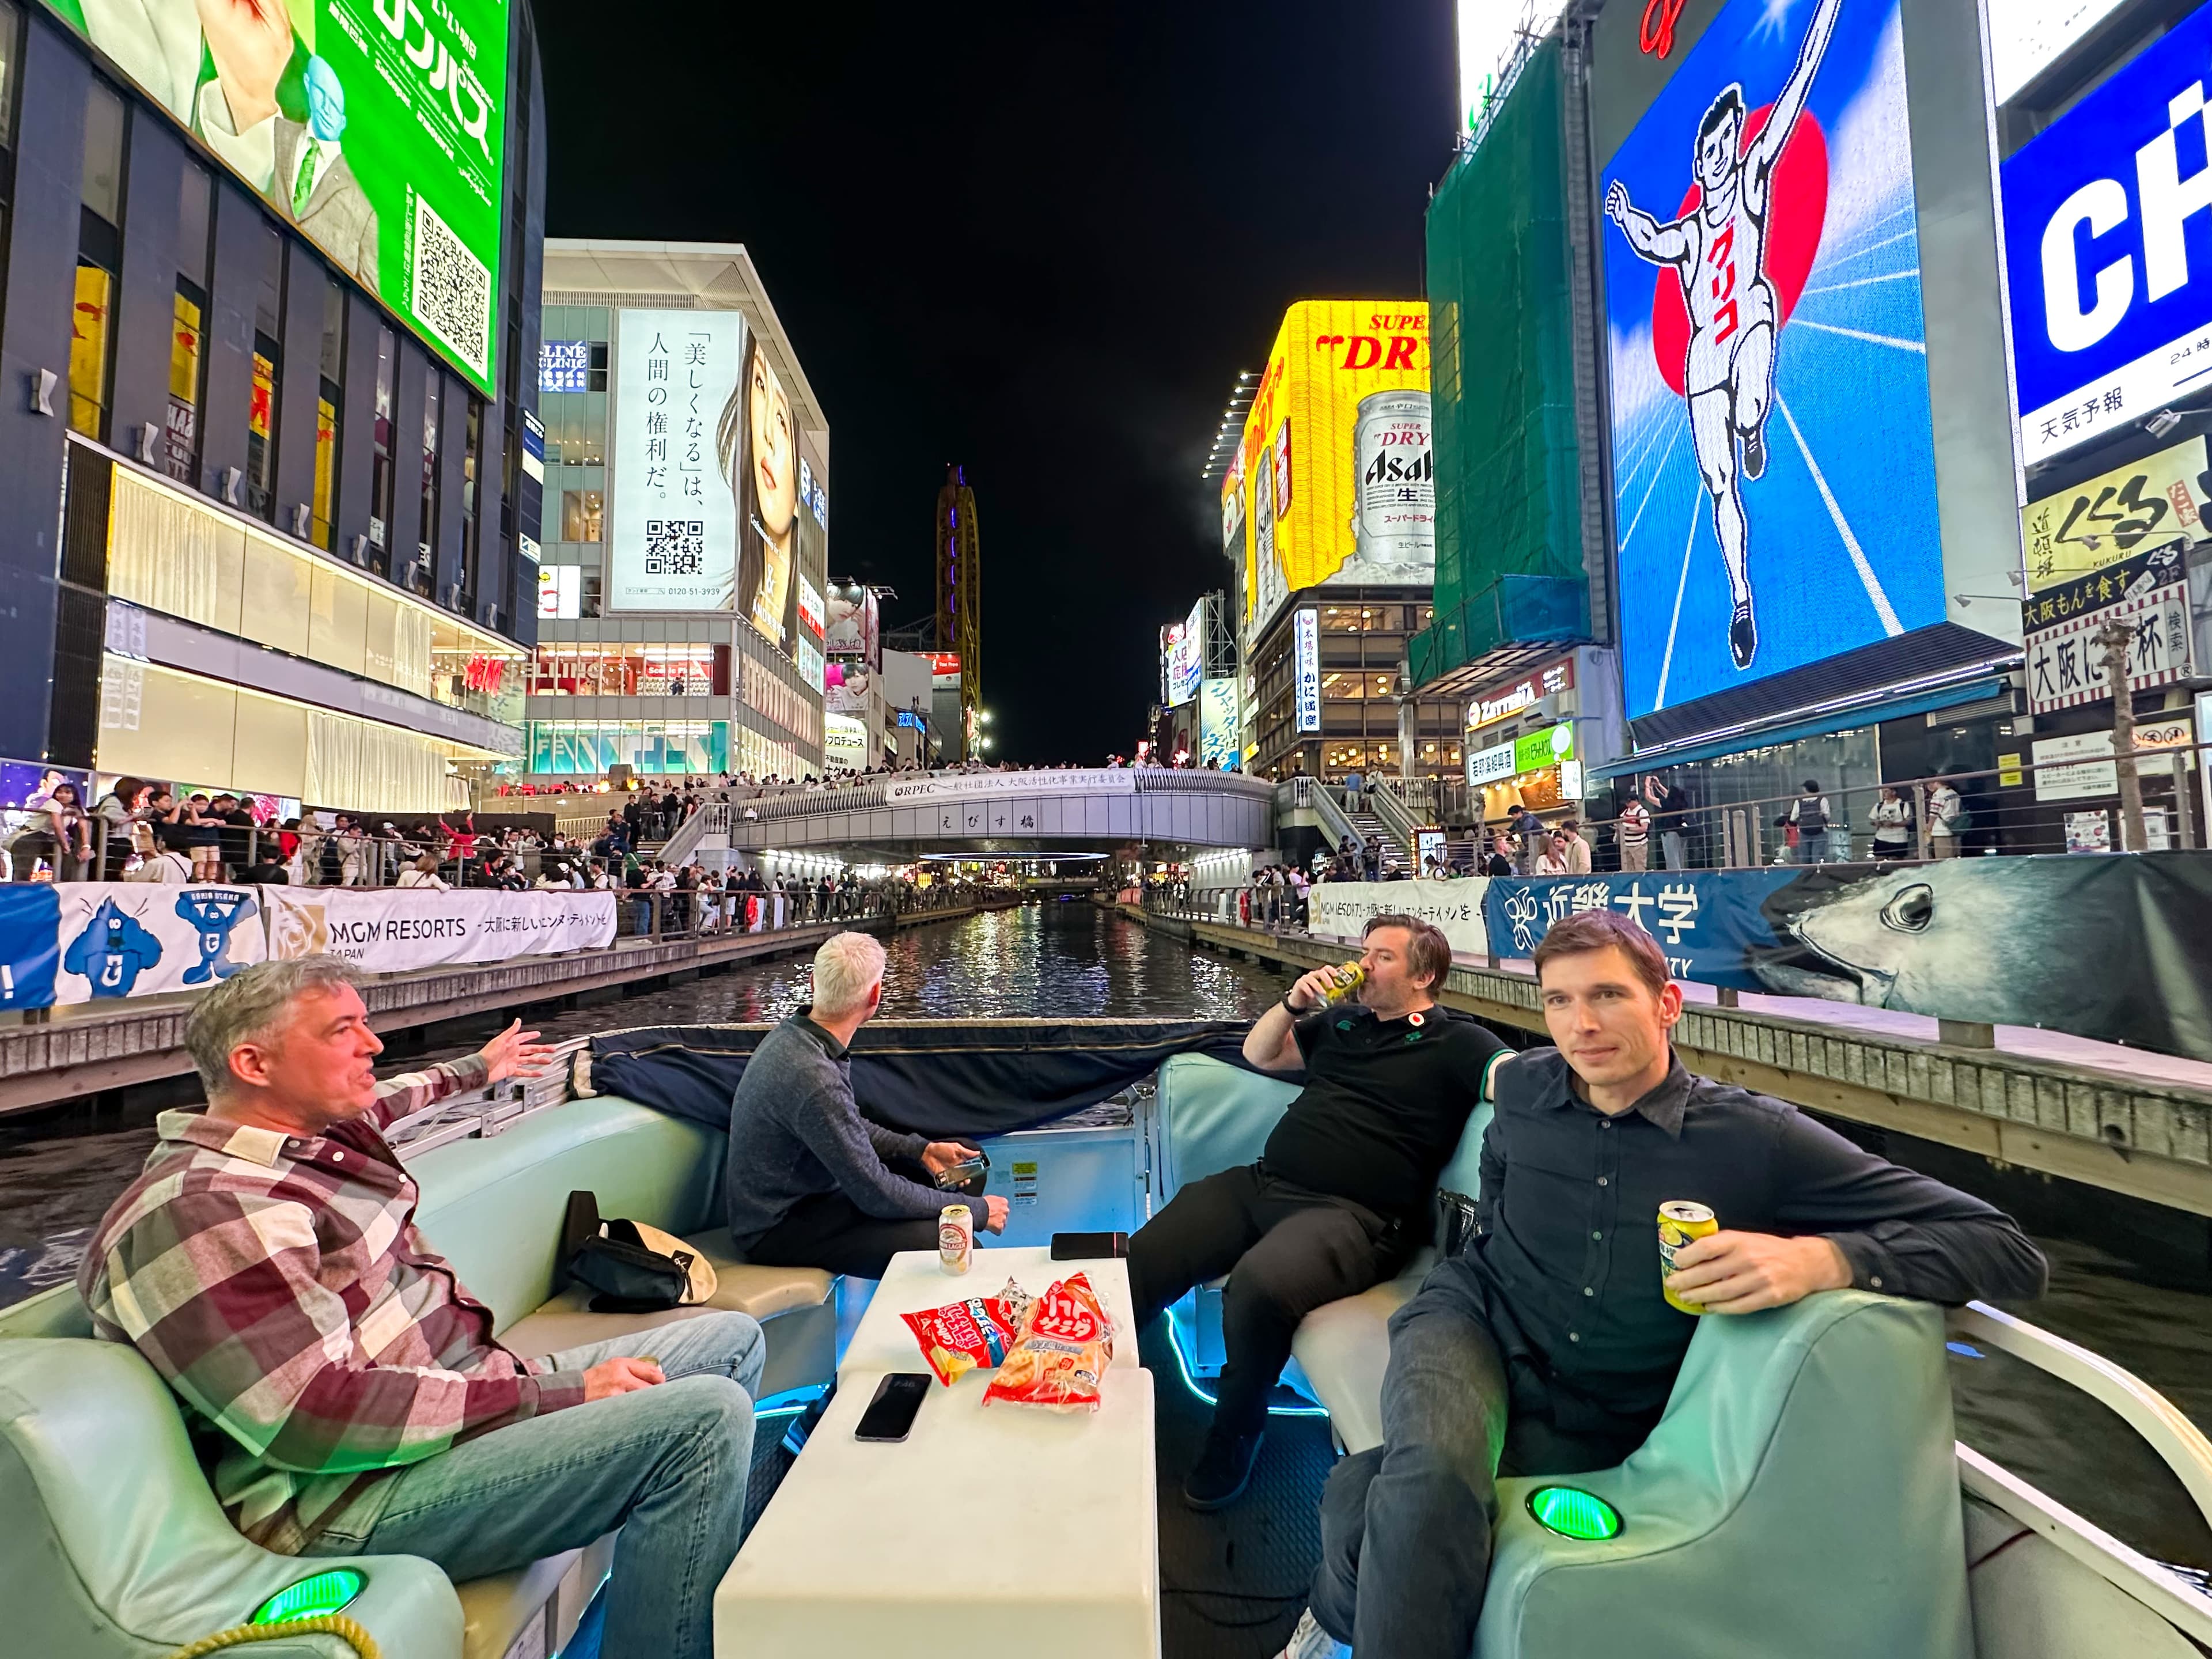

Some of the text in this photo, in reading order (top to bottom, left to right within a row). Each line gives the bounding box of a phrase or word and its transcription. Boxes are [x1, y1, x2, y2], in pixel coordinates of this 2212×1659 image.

[1707, 217, 1738, 346] グリコ
[1369, 315, 1427, 331] SUPE
[645, 332, 669, 499] 人間の権利だ。
[680, 332, 711, 506] 「美しくなる」は、
[2040, 387, 2124, 444] 天気予報
[1397, 487, 1419, 502] 生
[2054, 475, 2168, 549] くくる
[2032, 507, 2054, 579] 道頓堀
[2093, 551, 2131, 568] KUKURU
[668, 588, 720, 596] 0120-51-3939
[2157, 566, 2181, 586] 2F
[2024, 570, 2131, 627] 大阪もんを食す
[2167, 611, 2184, 652] 検索
[1304, 672, 1316, 726] かに道楽
[825, 755, 848, 765] 不動産業の
[942, 815, 1034, 830] えびす橋
[329, 921, 381, 944] MGM
[386, 918, 466, 941] RESORTS
[933, 1317, 955, 1345] Calbee
